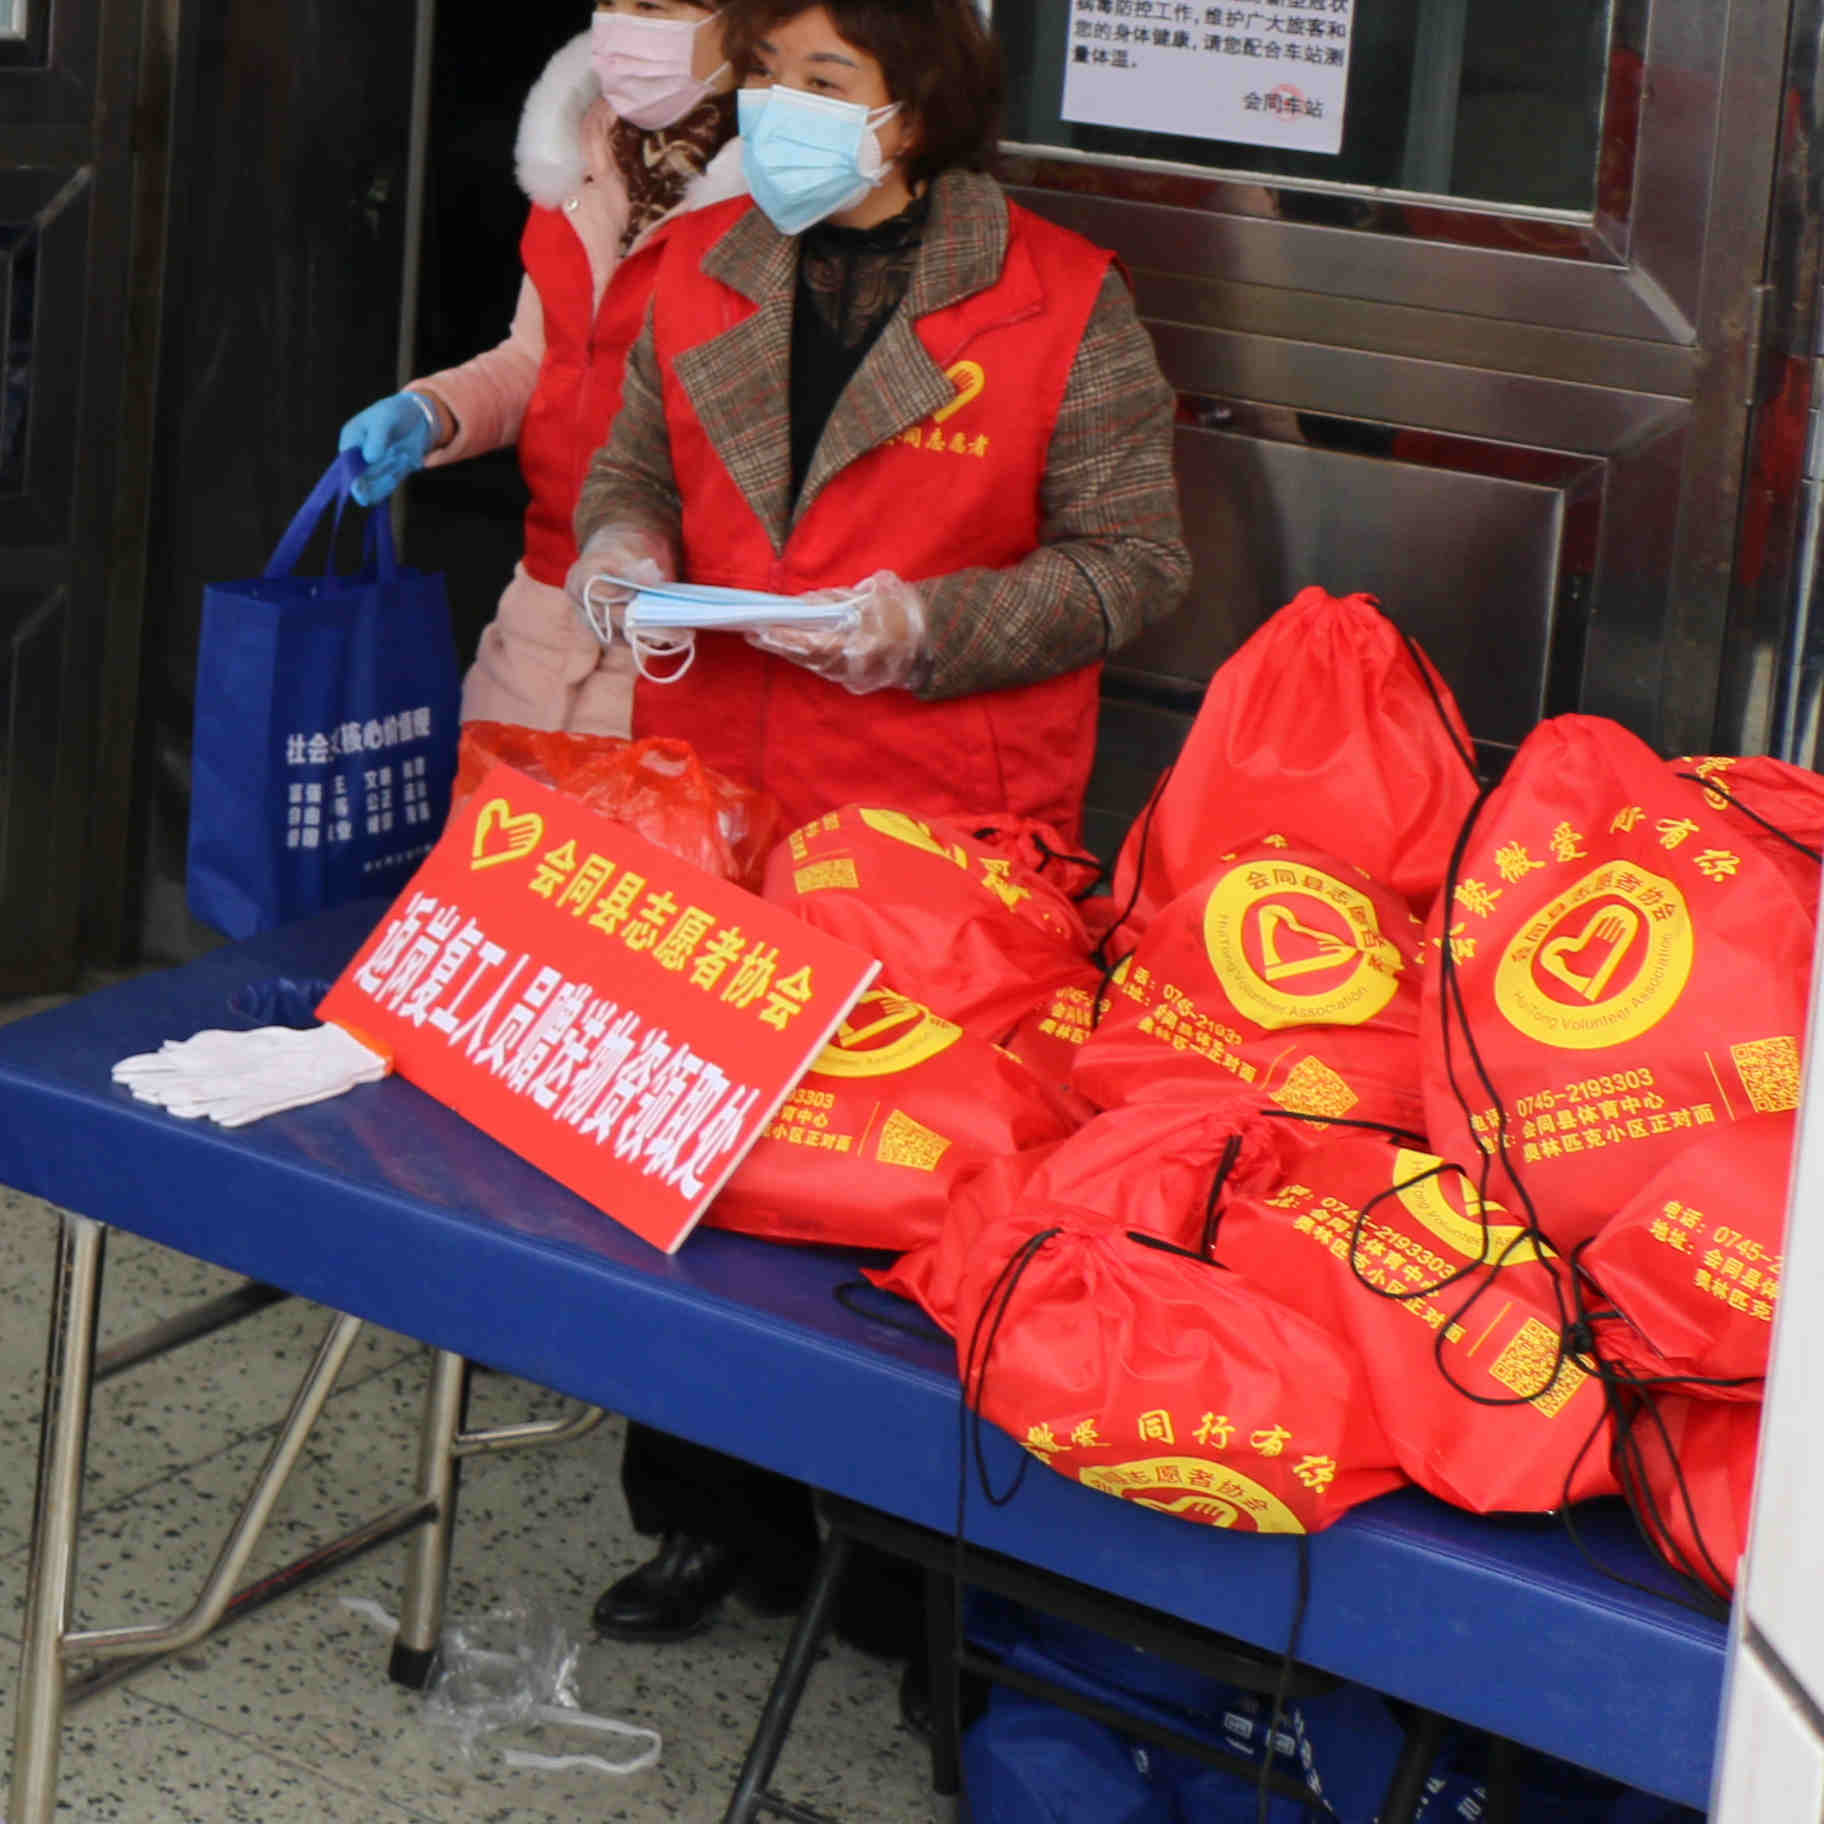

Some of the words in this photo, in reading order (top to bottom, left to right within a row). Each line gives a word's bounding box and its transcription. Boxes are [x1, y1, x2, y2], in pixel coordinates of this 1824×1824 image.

[1243, 90, 1323, 118] 会同车站
[886, 427, 990, 459] 同志愿者
[529, 839, 813, 1032] 会同县志愿者协会
[353, 890, 761, 1201] 返岗复工人员赠送物资领取处
[1517, 1068, 1654, 1118] 0745-2193303
[1522, 1090, 1664, 1139] 会同县体育中心
[1523, 1103, 1716, 1162] 奥林匹克小区正对面
